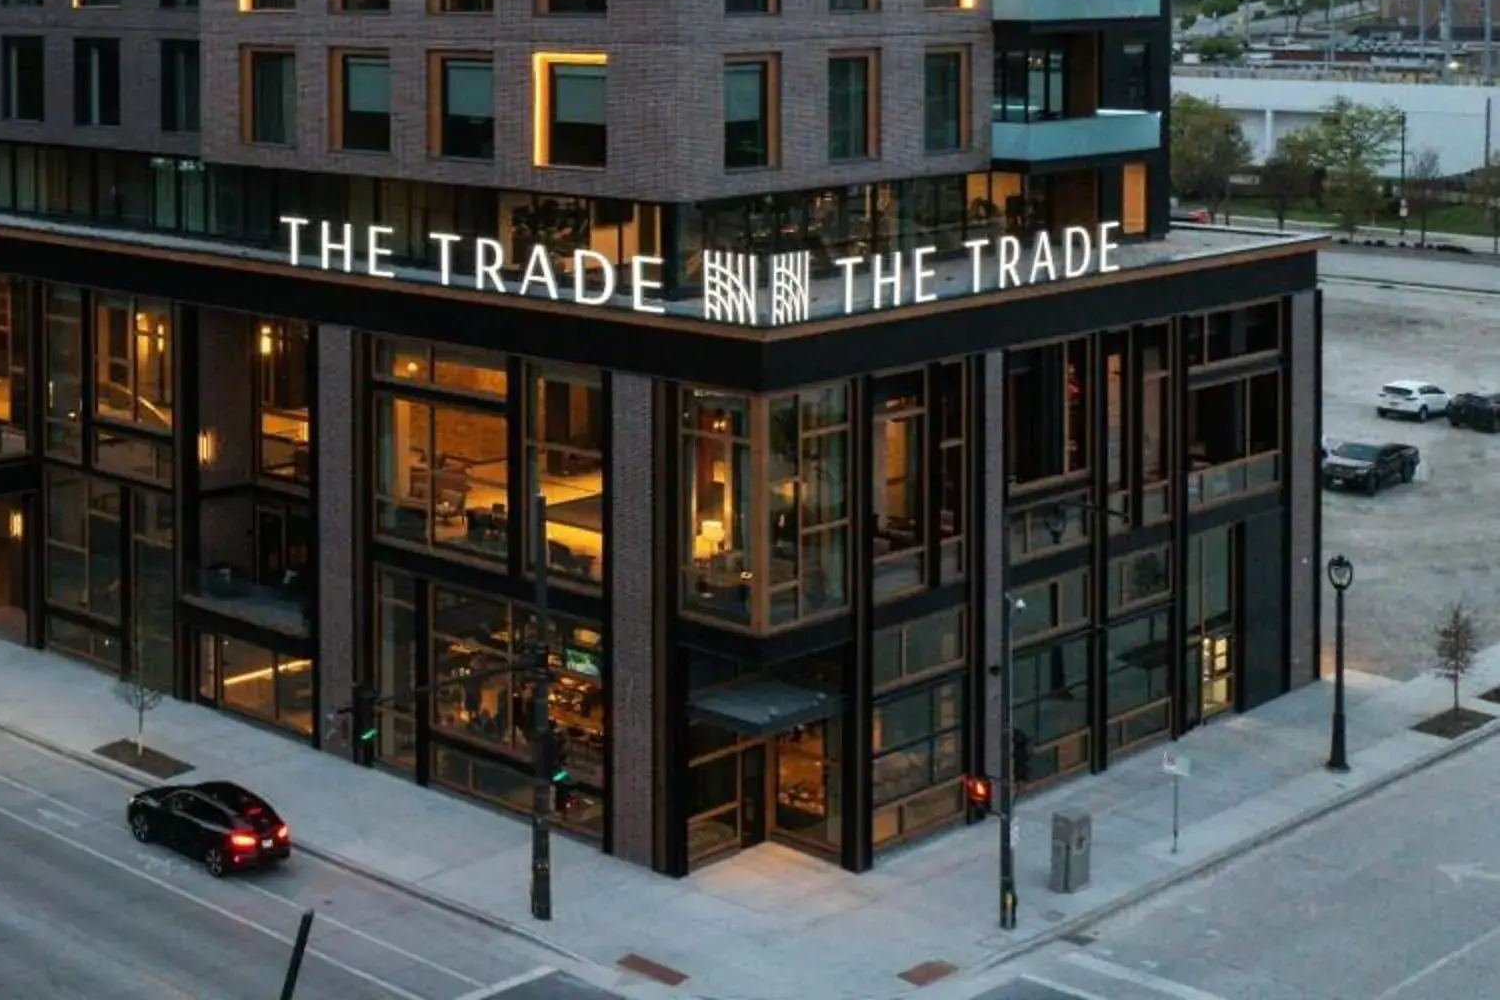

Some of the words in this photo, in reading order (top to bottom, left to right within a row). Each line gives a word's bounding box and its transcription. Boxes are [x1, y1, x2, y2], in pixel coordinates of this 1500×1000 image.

[279, 214, 396, 279] THE
[428, 231, 666, 315] TRADE
[834, 245, 938, 315] THE
[963, 220, 1121, 294] TRADE
